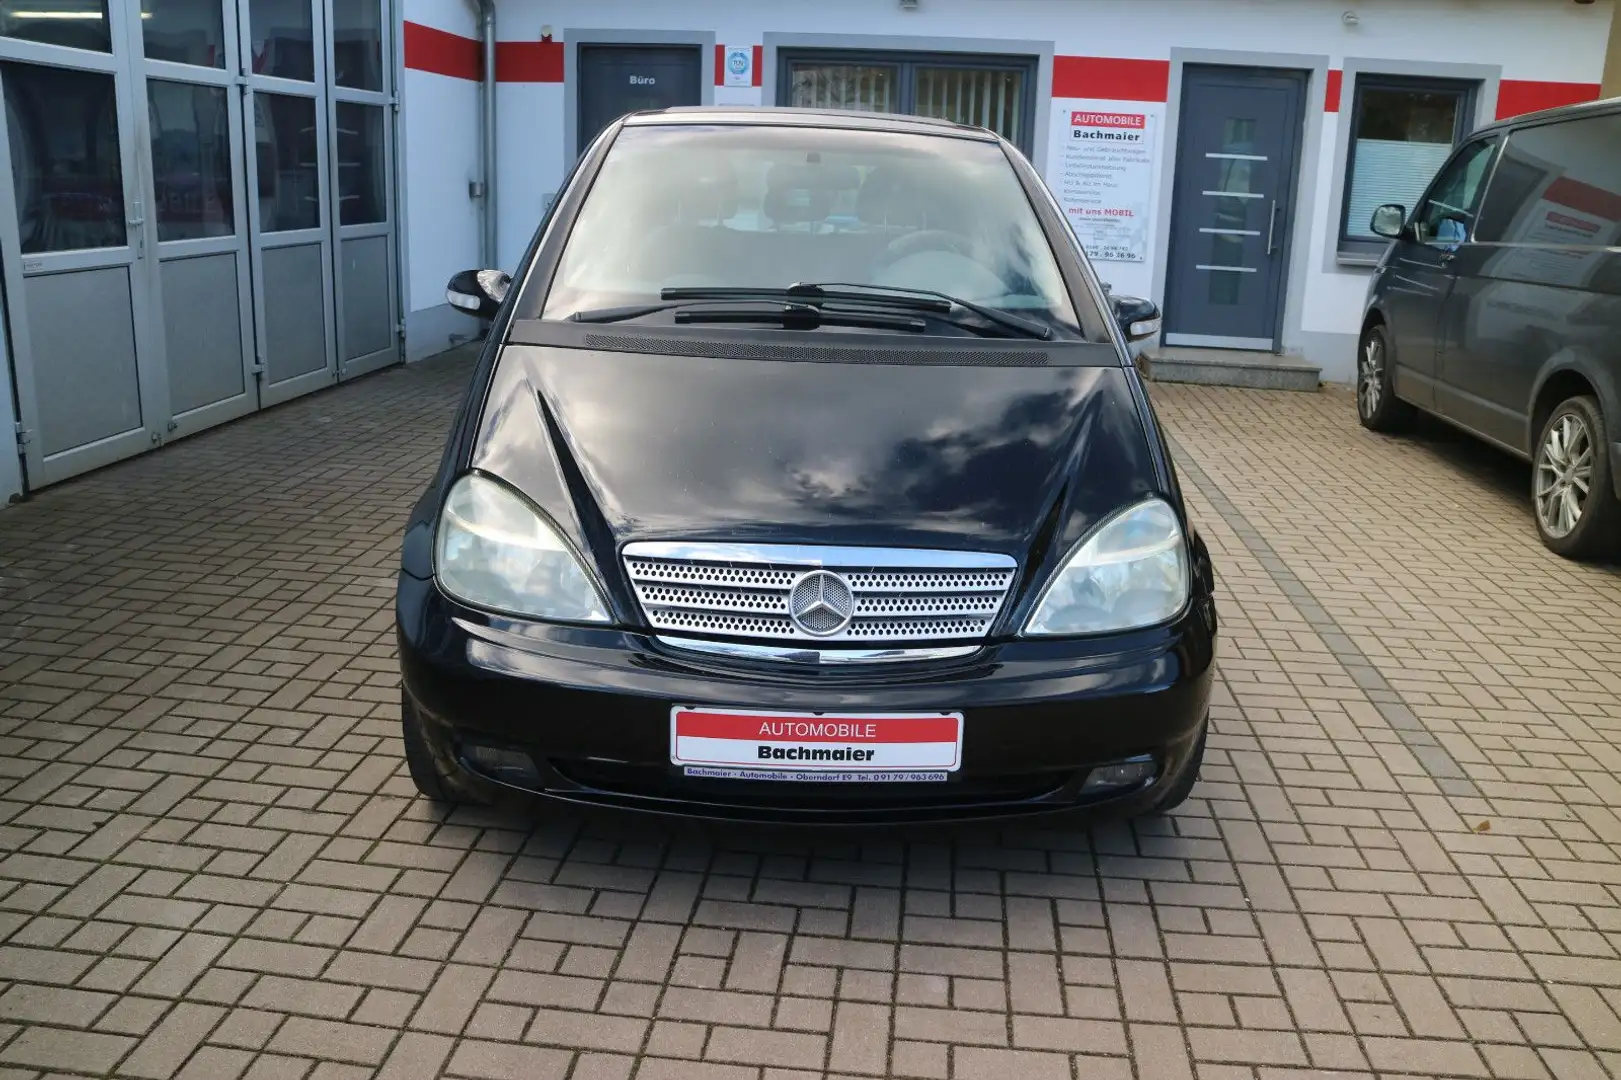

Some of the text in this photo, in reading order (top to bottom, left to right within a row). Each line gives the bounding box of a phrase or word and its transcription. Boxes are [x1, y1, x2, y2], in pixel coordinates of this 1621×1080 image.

[629, 75, 656, 85] Büro
[1074, 114, 1142, 126] AUTOMOBILE
[1073, 129, 1140, 141] Bachmaier
[1104, 209, 1134, 217] MOBIL
[759, 722, 877, 738] AUTOMOBILE
[757, 745, 875, 761] Bachmaier
[687, 768, 731, 777] Bachmaier
[740, 771, 788, 780] Automobile
